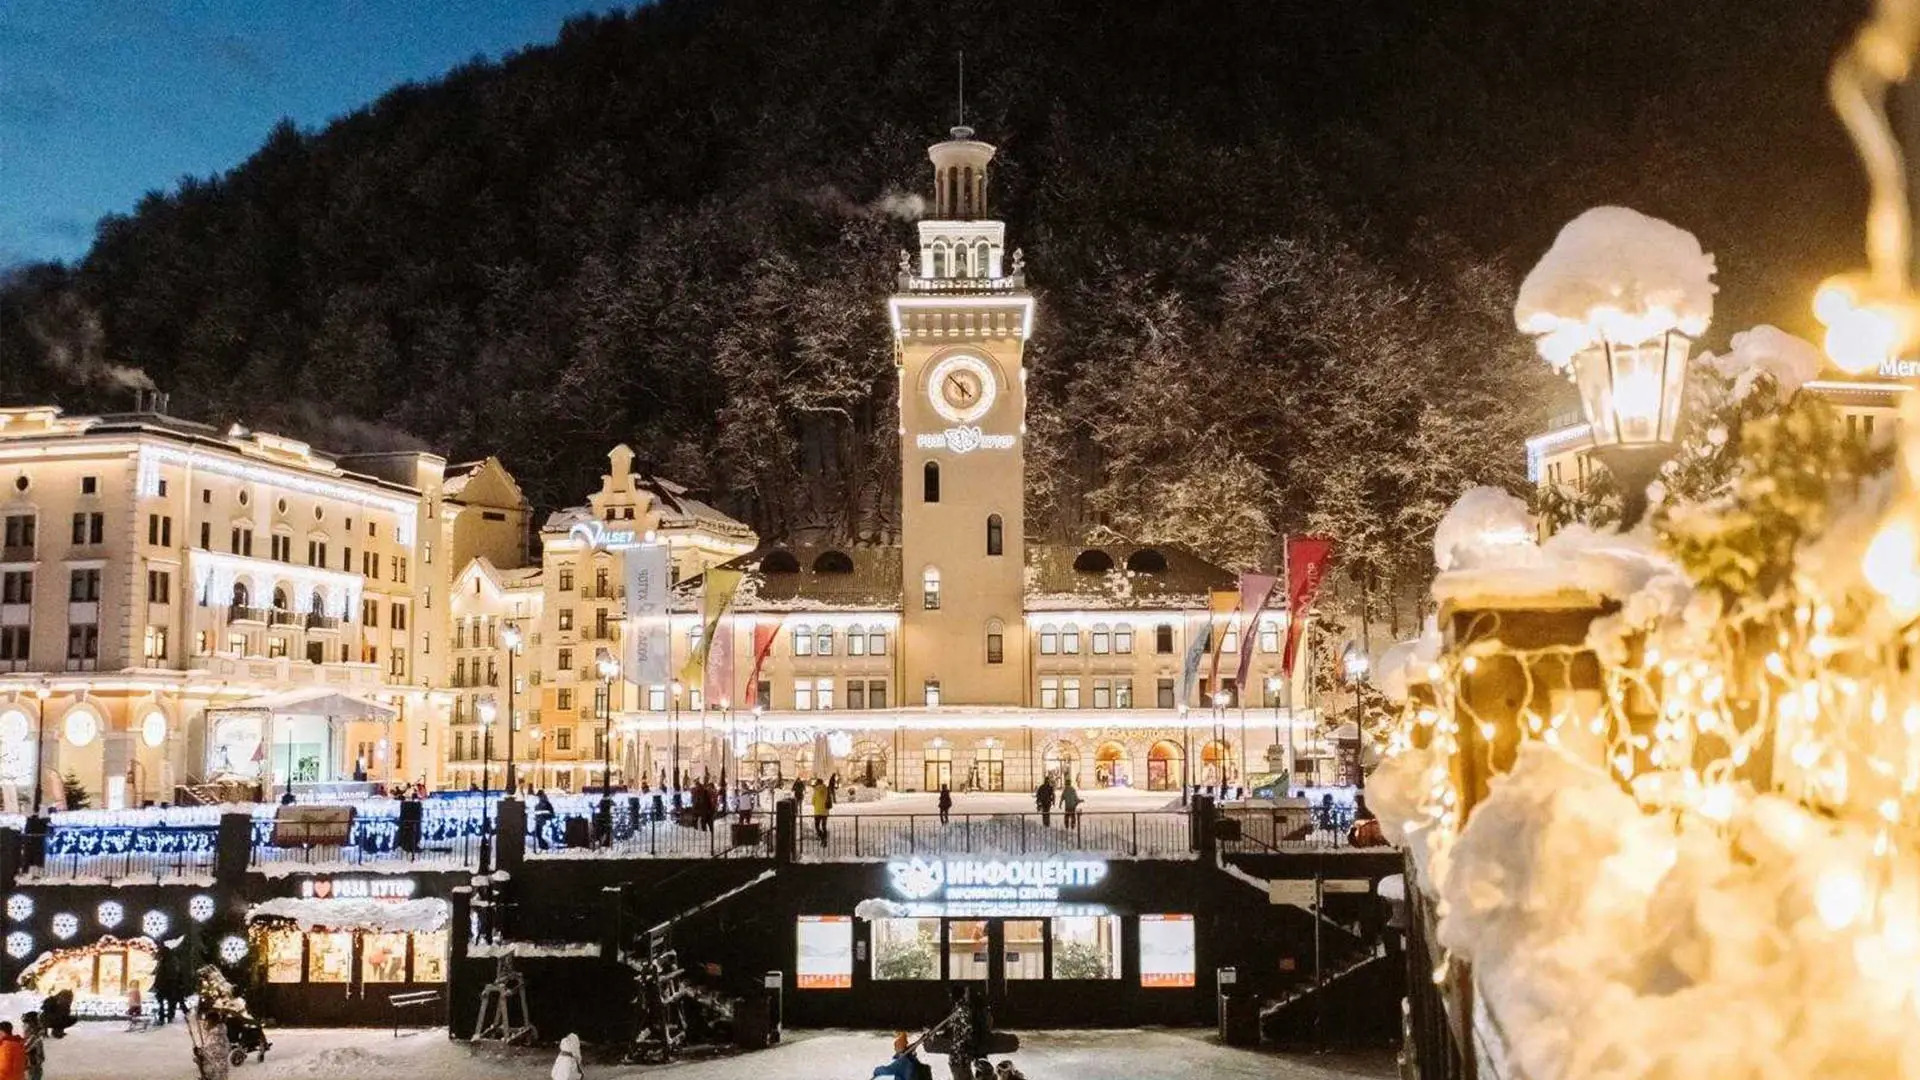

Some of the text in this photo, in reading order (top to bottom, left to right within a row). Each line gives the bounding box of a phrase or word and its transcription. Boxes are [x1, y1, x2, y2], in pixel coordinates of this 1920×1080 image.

[572, 521, 636, 549] VALSET
[946, 860, 1107, 889] ИНФОЦЕНТР
[332, 880, 368, 897] РОЗА
[371, 880, 416, 897] ХУТОР
[946, 886, 1017, 900] INFORMATION
